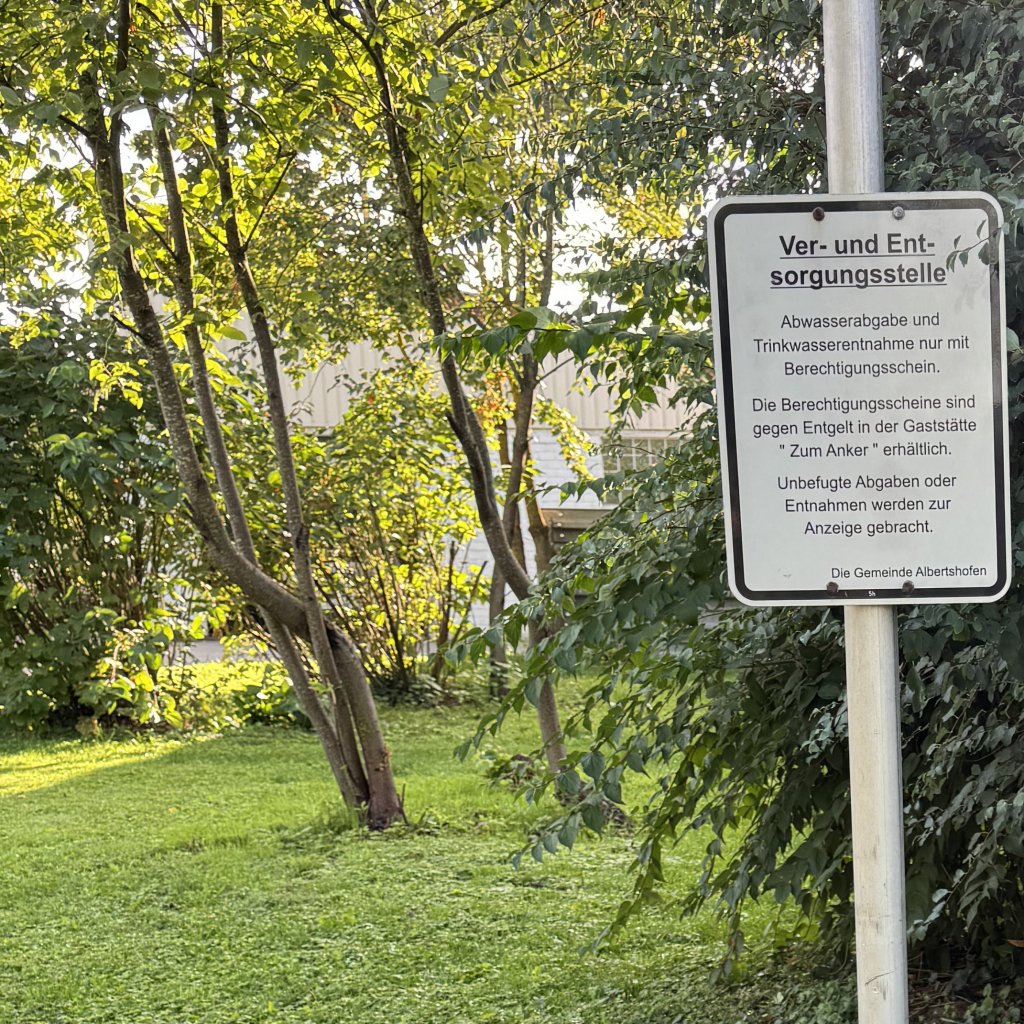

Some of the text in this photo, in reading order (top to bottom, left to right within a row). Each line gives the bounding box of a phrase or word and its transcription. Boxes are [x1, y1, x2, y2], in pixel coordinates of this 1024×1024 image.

[779, 232, 936, 256] Ver- und Ent-
[770, 263, 946, 289] sorgungsstelle
[781, 311, 940, 329] Abwasserabgabe und
[754, 335, 970, 352] Trinkwasserentnahme nur mit
[784, 359, 940, 378] Berechtigungsschein.
[752, 394, 976, 414] Die Berechtigungsscheine sind
[753, 417, 976, 438] gegen Entgelt in der Gaststätte
[790, 443, 822, 458] Zum
[826, 443, 868, 456] Anker
[883, 441, 952, 456] erhältlich.
[778, 473, 956, 492] Unbefugte Abgaben oder
[786, 497, 951, 512] Entnahmen werden zur
[804, 519, 933, 537] Anzeige gebracht.
[832, 565, 986, 578] Die Gemeinde Albertshofen
